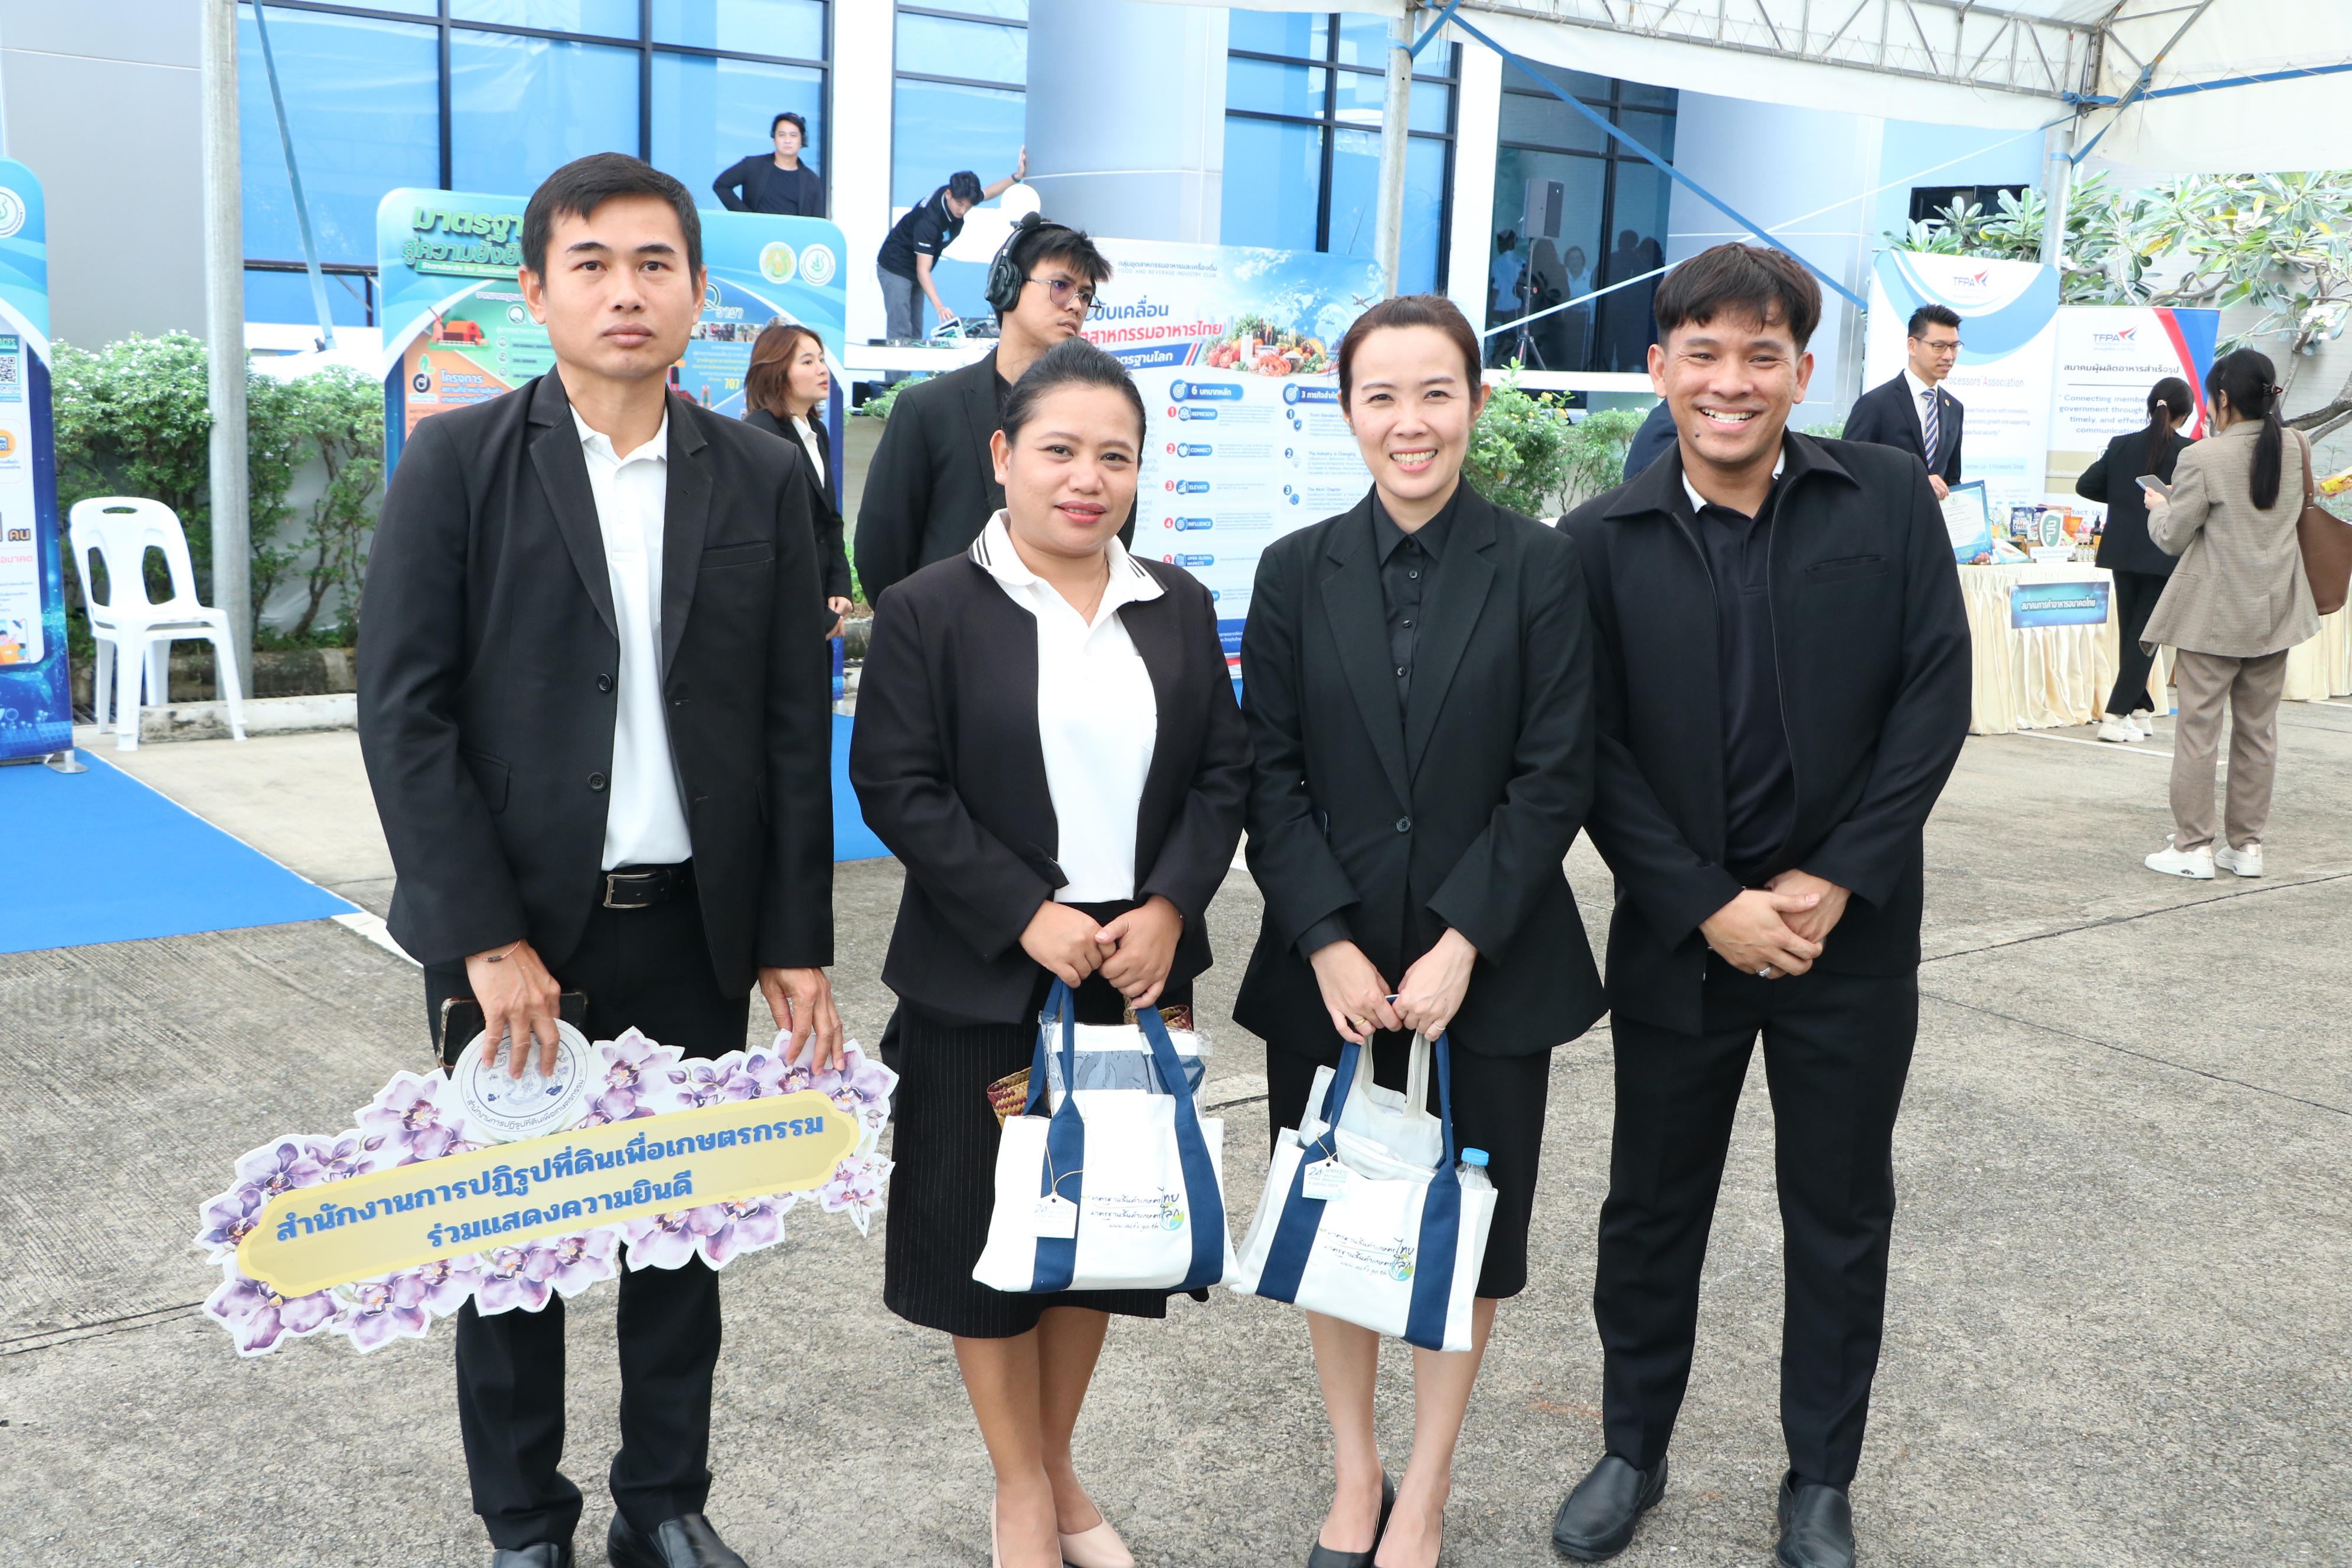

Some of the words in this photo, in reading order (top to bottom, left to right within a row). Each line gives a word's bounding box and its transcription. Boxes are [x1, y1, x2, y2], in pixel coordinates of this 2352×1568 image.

[422, 262, 463, 272] Standards
[1118, 260, 1217, 271] กลุ่มอุตสาหกรรมอาหารและเครื่องดื่ม
[1953, 277, 1975, 287] TFPA
[2064, 364, 2179, 375] สมาคมผู้ผลิตอาหารสำเร็จรูป
[1983, 377, 2024, 387] Association
[1191, 385, 1197, 395] 6
[1200, 387, 1232, 396] บทบาทหลัก
[2064, 394, 2112, 403] Connecting
[1170, 407, 1174, 416] 1
[1168, 445, 1174, 453] 2
[1167, 481, 1172, 490] 3
[8, 528, 31, 542] คน
[2021, 596, 2096, 610] สมาคมการค้าอาหารอนาคตไทย
[466, 1079, 584, 1130] สำนักงานการปฏิรูปที่ดินเพื่อเกษตรกรรม
[1308, 1167, 1322, 1175] 24
[276, 1116, 824, 1242] สำนักงานการปฏิรูปที่ดินเพื่อเกษตรกรรม
[427, 1170, 692, 1248] ร่วมแสดงความยินดี
[1109, 1222, 1158, 1231] www.acfs.go.th
[1340, 1261, 1387, 1276] www.acfs.go.th
